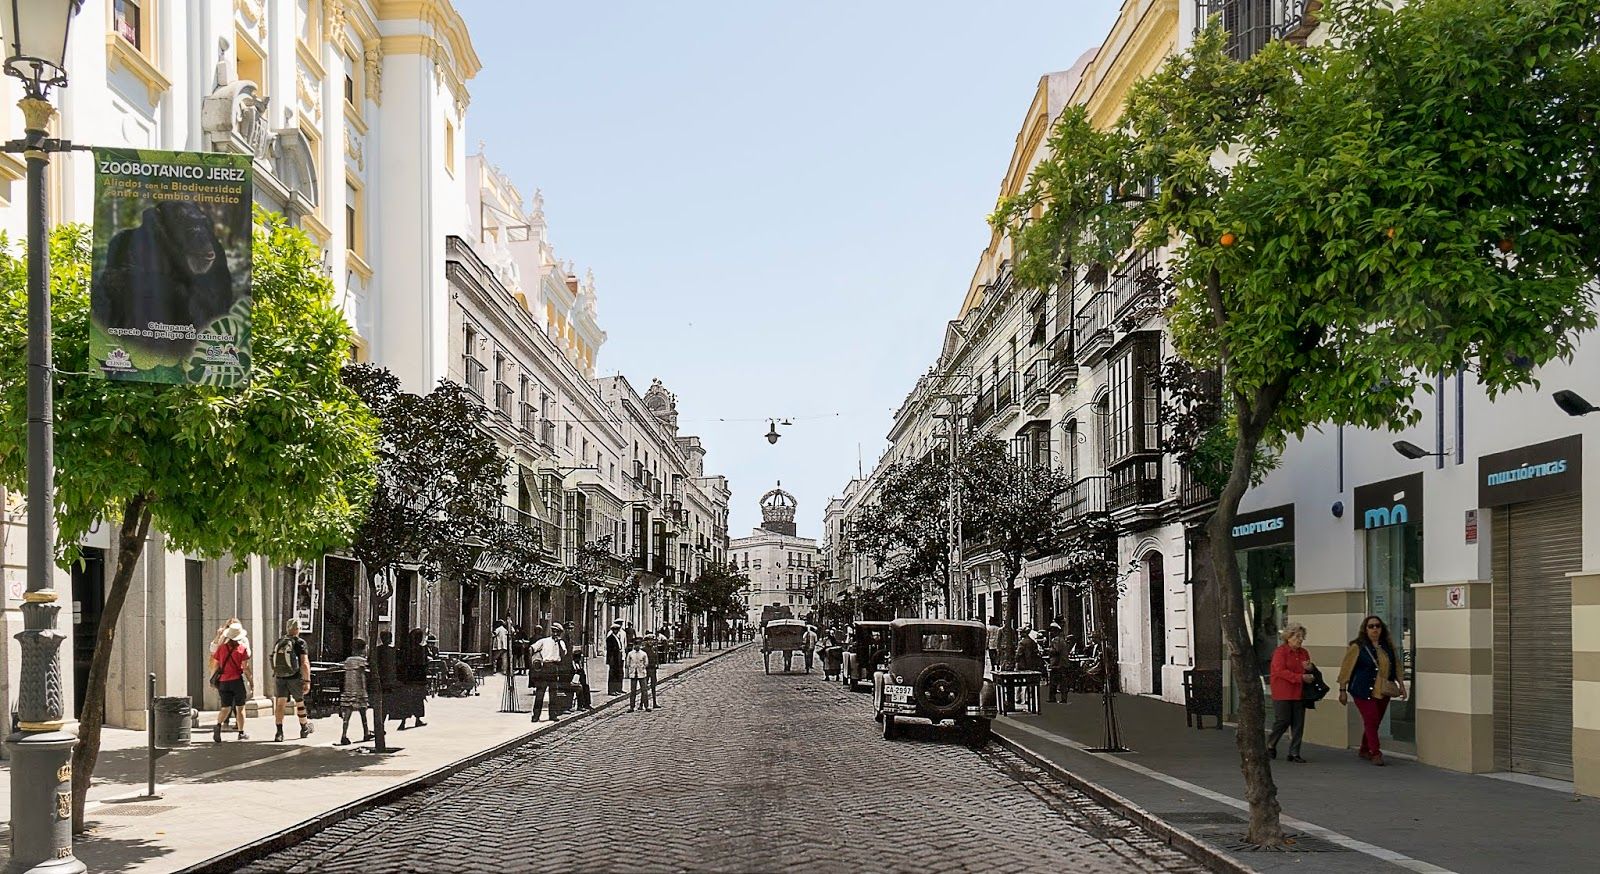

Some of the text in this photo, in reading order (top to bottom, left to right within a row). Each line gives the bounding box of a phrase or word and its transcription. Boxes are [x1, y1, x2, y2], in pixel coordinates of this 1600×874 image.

[100, 161, 245, 181] ZOOBOTÁNICO JEREZ
[103, 177, 142, 188] Aliados
[171, 181, 242, 195] Biodiversidad
[152, 192, 190, 201] cambio
[192, 193, 240, 204] climático
[108, 327, 235, 342] especie en peligro de extinción
